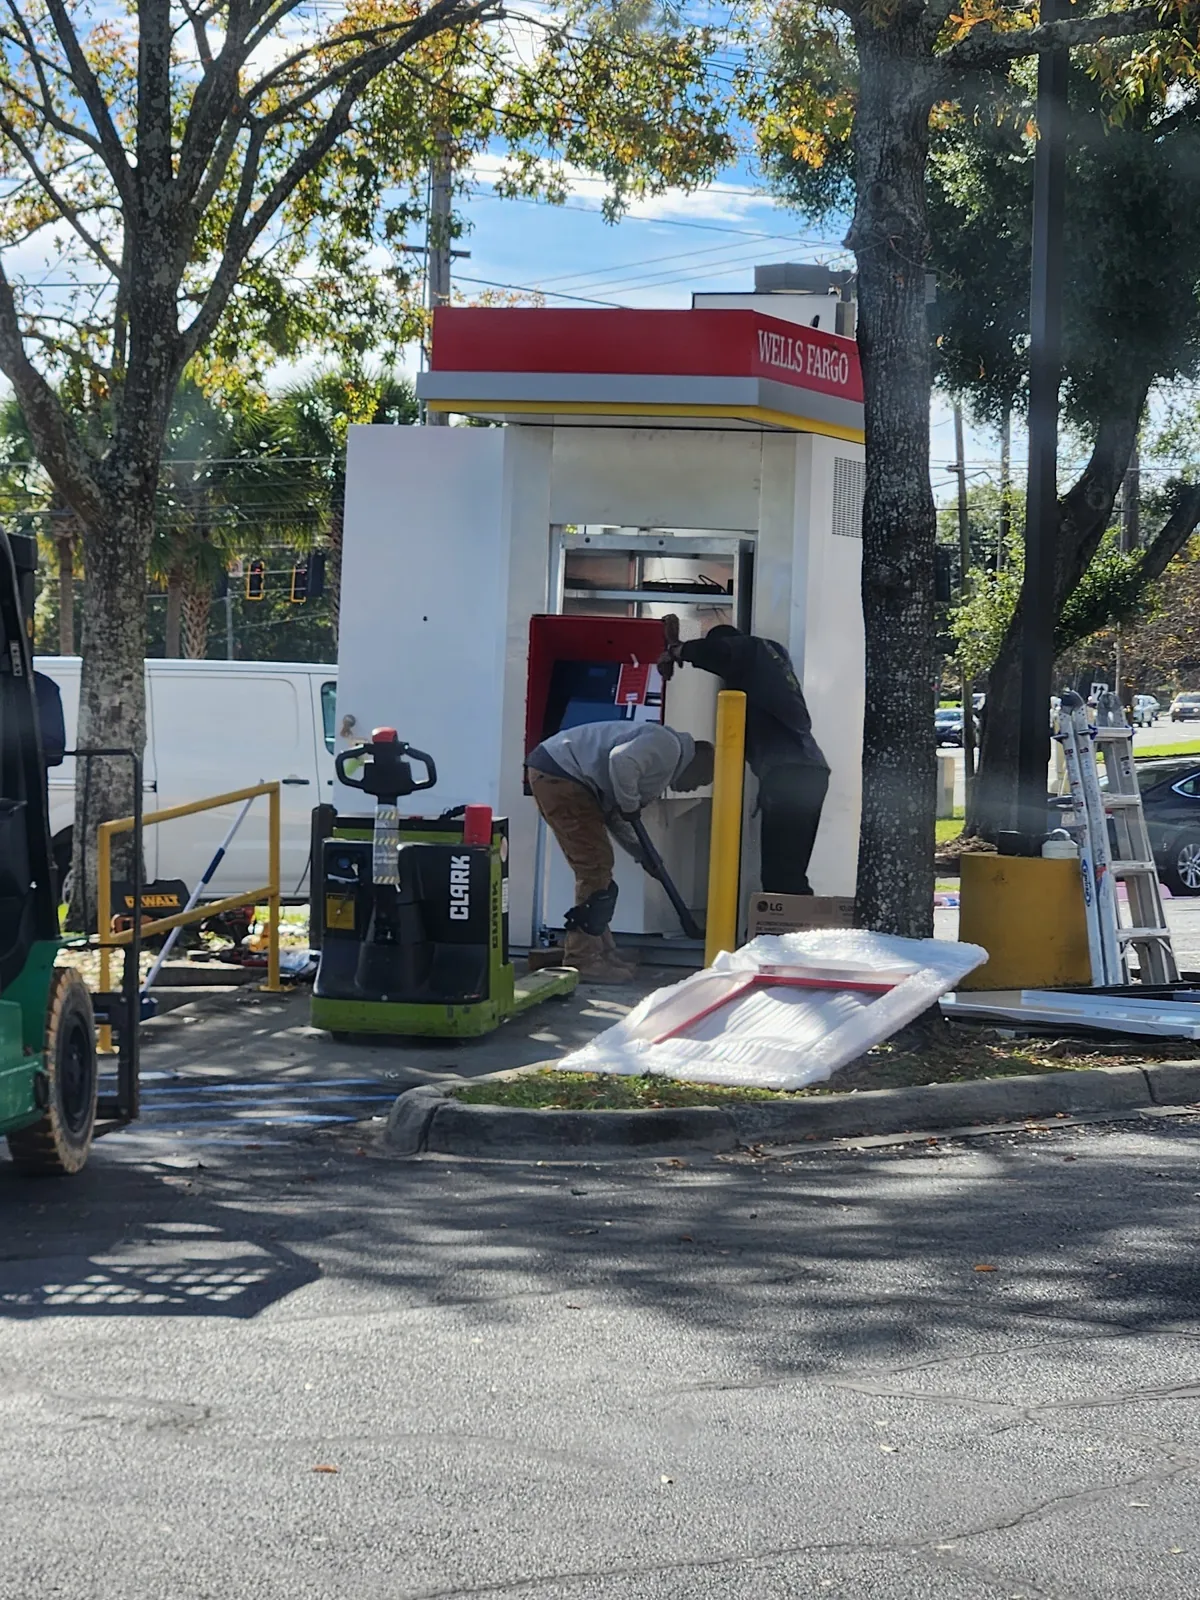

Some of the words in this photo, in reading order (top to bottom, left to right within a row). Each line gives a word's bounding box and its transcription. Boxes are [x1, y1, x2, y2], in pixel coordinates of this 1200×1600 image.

[757, 329, 803, 373] WELLS
[806, 343, 849, 385] FARGO
[124, 894, 180, 909] DWALT
[449, 855, 471, 920] CLARK
[769, 902, 783, 912] LG
